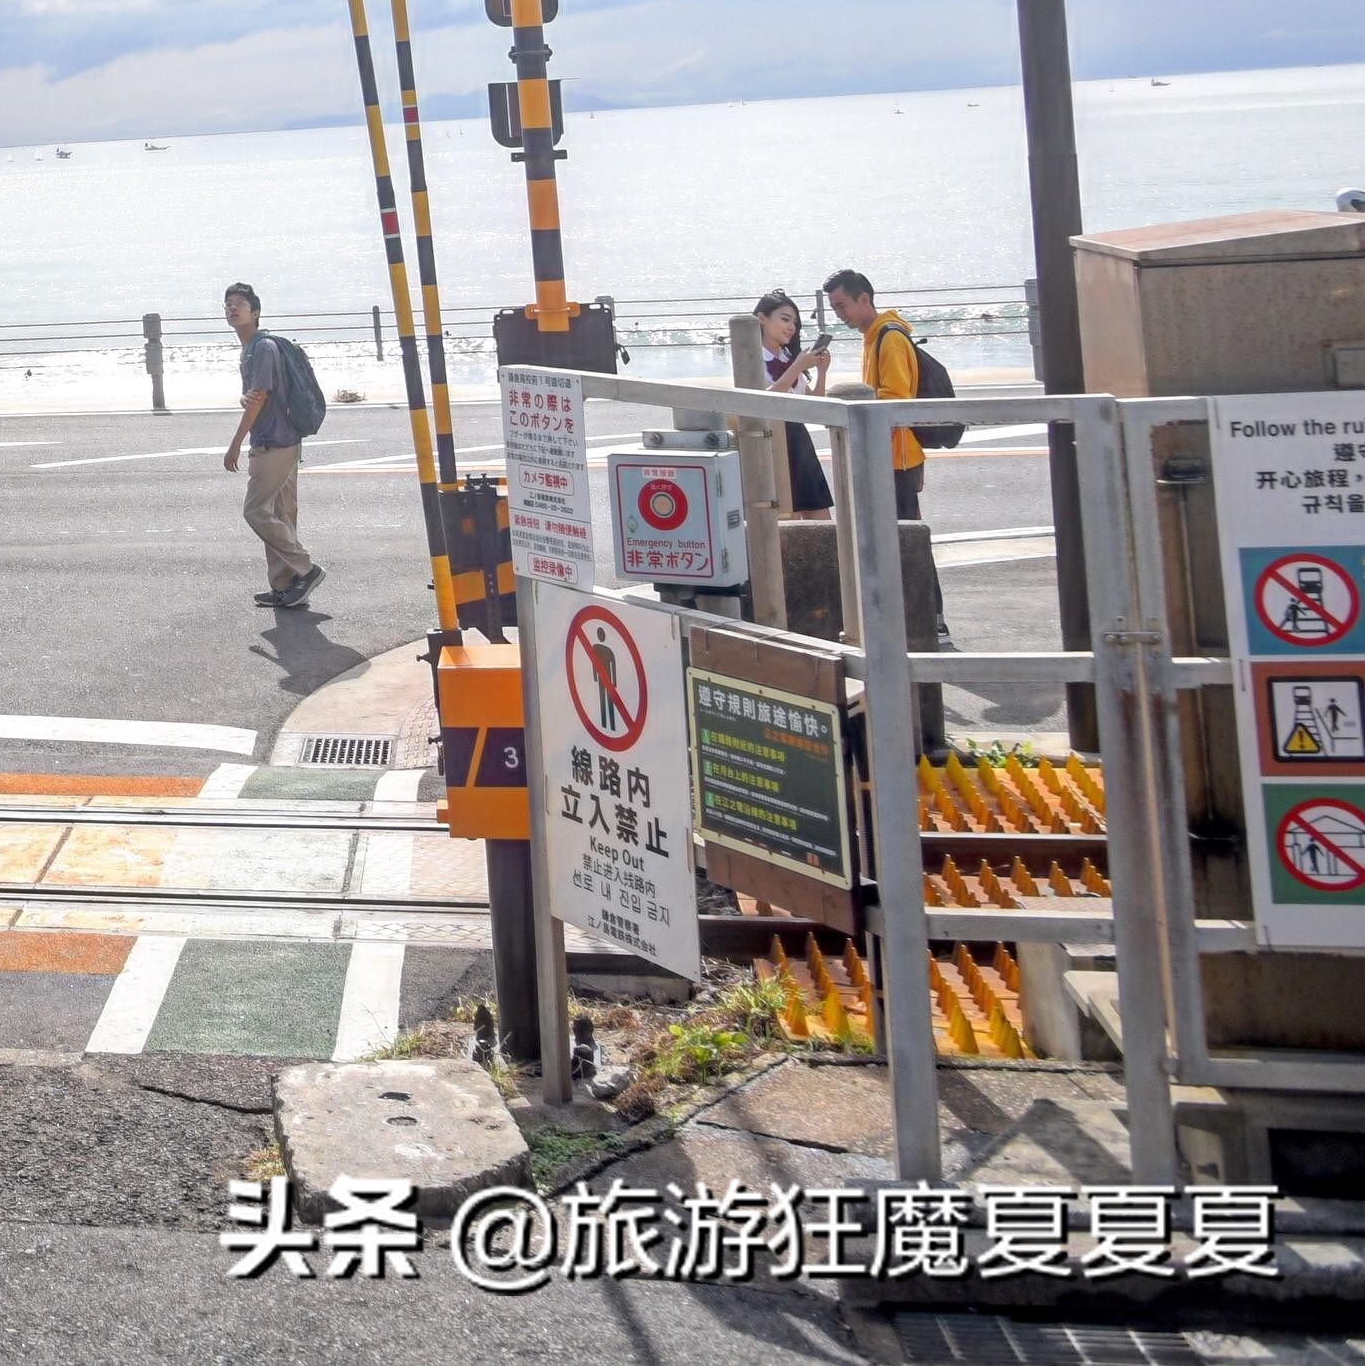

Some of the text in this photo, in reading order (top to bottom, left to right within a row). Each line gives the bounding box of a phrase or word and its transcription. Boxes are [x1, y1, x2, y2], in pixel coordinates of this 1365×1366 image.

[509, 389, 572, 413] 非常の際は
[510, 410, 574, 434] このボタンを
[1230, 421, 1296, 438] Follow
[1303, 419, 1336, 435] the
[523, 471, 568, 489] カメラ監視中
[1302, 494, 1365, 514] 규칙을
[627, 537, 706, 549] Emergency button
[627, 550, 709, 571] 非常ボタン
[503, 747, 519, 768] 3
[571, 745, 651, 808] 線路内
[561, 784, 669, 858] 立入禁止
[590, 835, 645, 872] Keep Out
[573, 869, 670, 927] 선로 내 진입 금지
